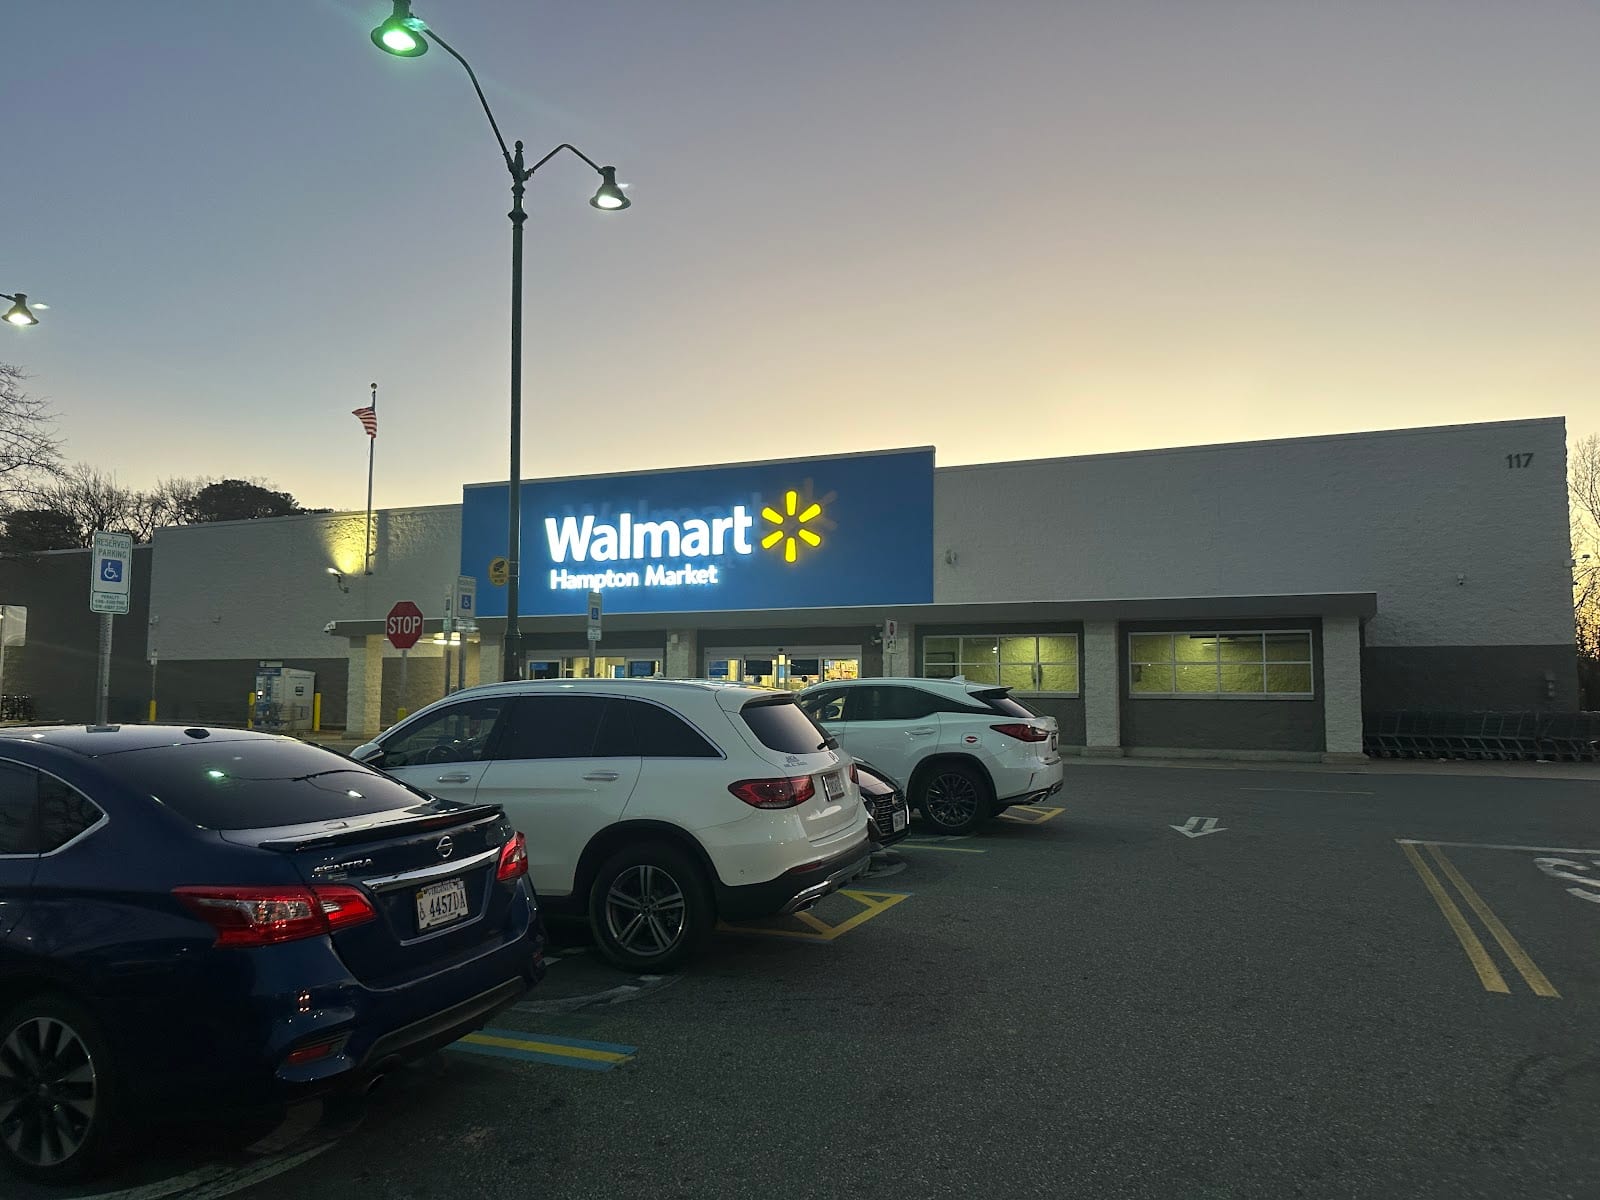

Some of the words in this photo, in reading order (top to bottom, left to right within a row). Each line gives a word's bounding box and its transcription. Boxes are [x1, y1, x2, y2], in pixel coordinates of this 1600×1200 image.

[1505, 453, 1534, 468] 117
[544, 505, 754, 563] Walmart
[97, 538, 130, 549] RESERVED
[98, 548, 127, 559] PARKING
[550, 568, 639, 592] Hampton
[645, 563, 719, 587] Market
[388, 616, 421, 634] STOP
